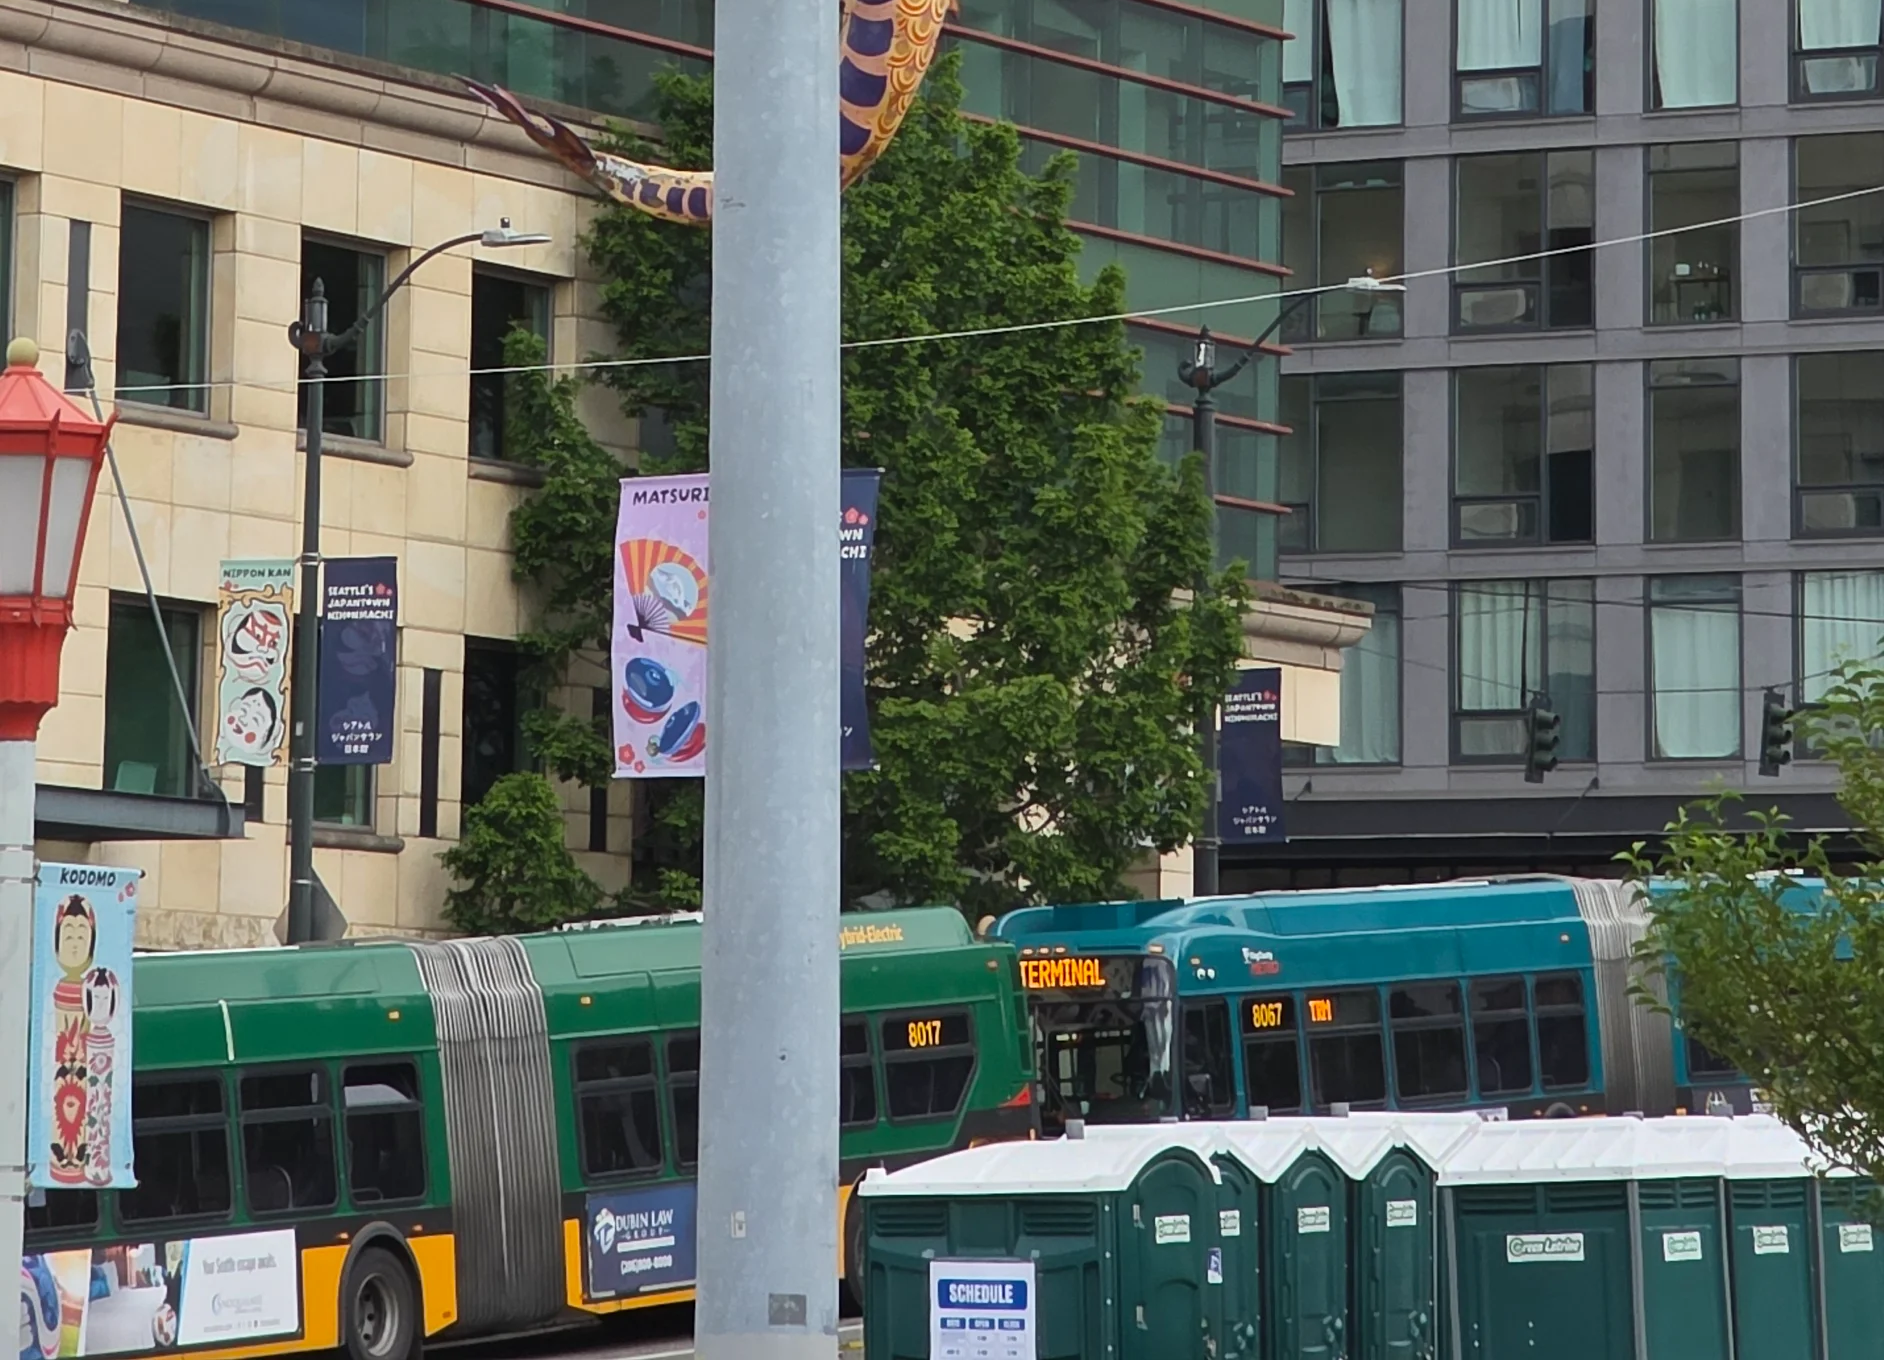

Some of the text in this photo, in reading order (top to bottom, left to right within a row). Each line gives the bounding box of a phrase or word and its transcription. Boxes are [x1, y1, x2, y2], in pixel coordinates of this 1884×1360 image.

[633, 487, 710, 506] MATSURI
[223, 567, 291, 578] NIPPON KAN
[328, 584, 373, 596] SEATTLE'S
[327, 597, 391, 608] JAPANTOWN
[60, 867, 116, 886] KODOMO
[839, 923, 904, 950] ybrid-Electric
[1019, 958, 1106, 989] TERMINAL
[1252, 1002, 1282, 1028] 8067
[908, 1020, 941, 1048] 8017
[616, 1209, 674, 1232] DUBIN LAW
[949, 1283, 1014, 1304] SCHEDULE
